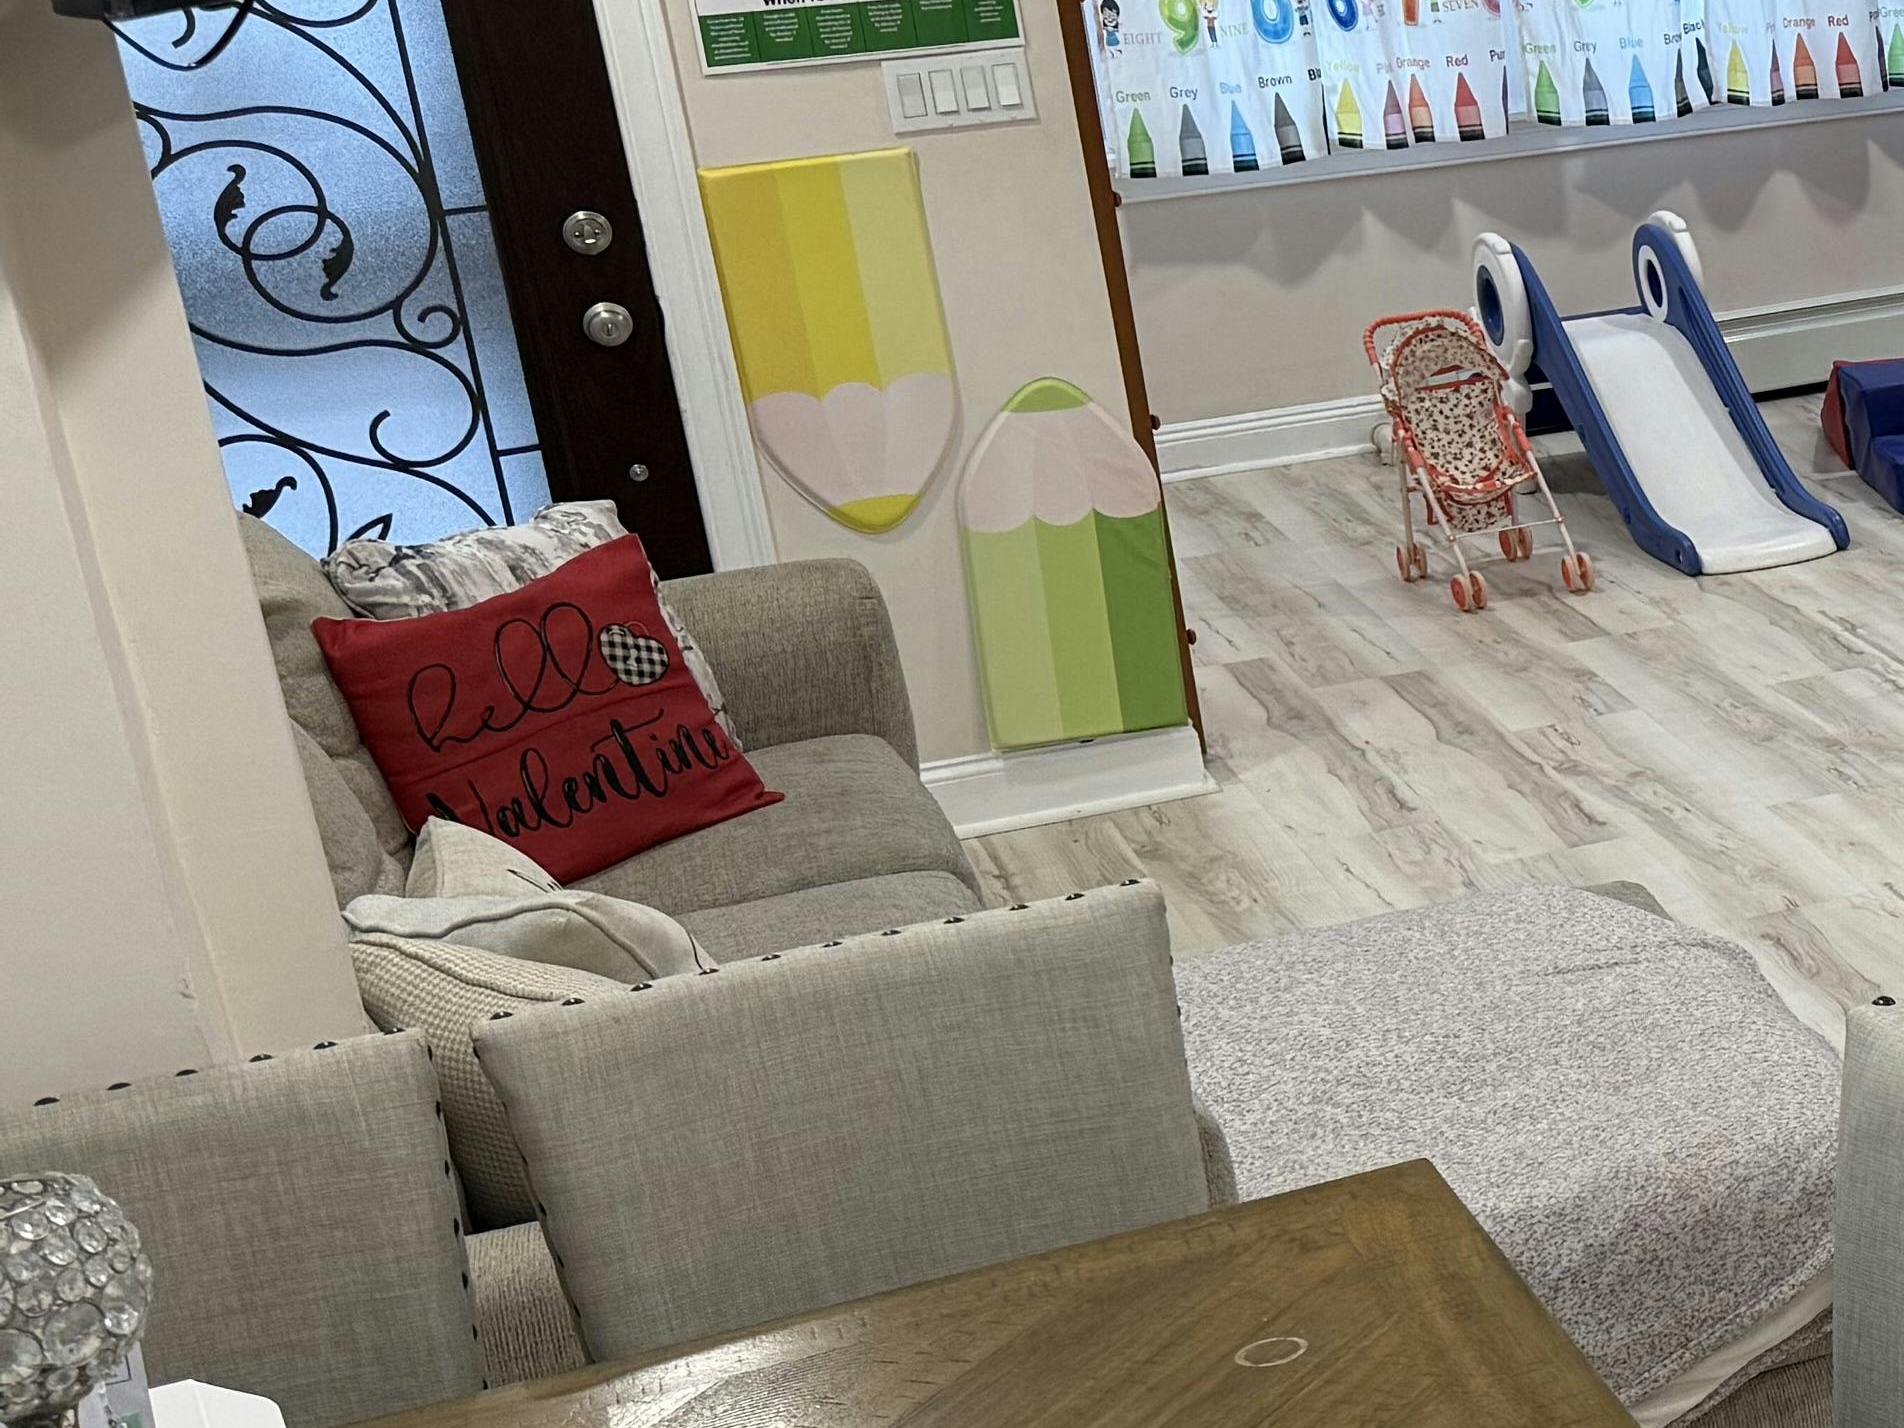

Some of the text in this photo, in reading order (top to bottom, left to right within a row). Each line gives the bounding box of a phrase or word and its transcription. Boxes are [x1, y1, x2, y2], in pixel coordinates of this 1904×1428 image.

[1827, 15, 1849, 28] Red
[1123, 33, 1162, 45] EIGHT
[1446, 53, 1469, 67] Red
[1258, 74, 1293, 89] Brown
[1116, 89, 1151, 104] Green
[1170, 86, 1198, 101] Grey
